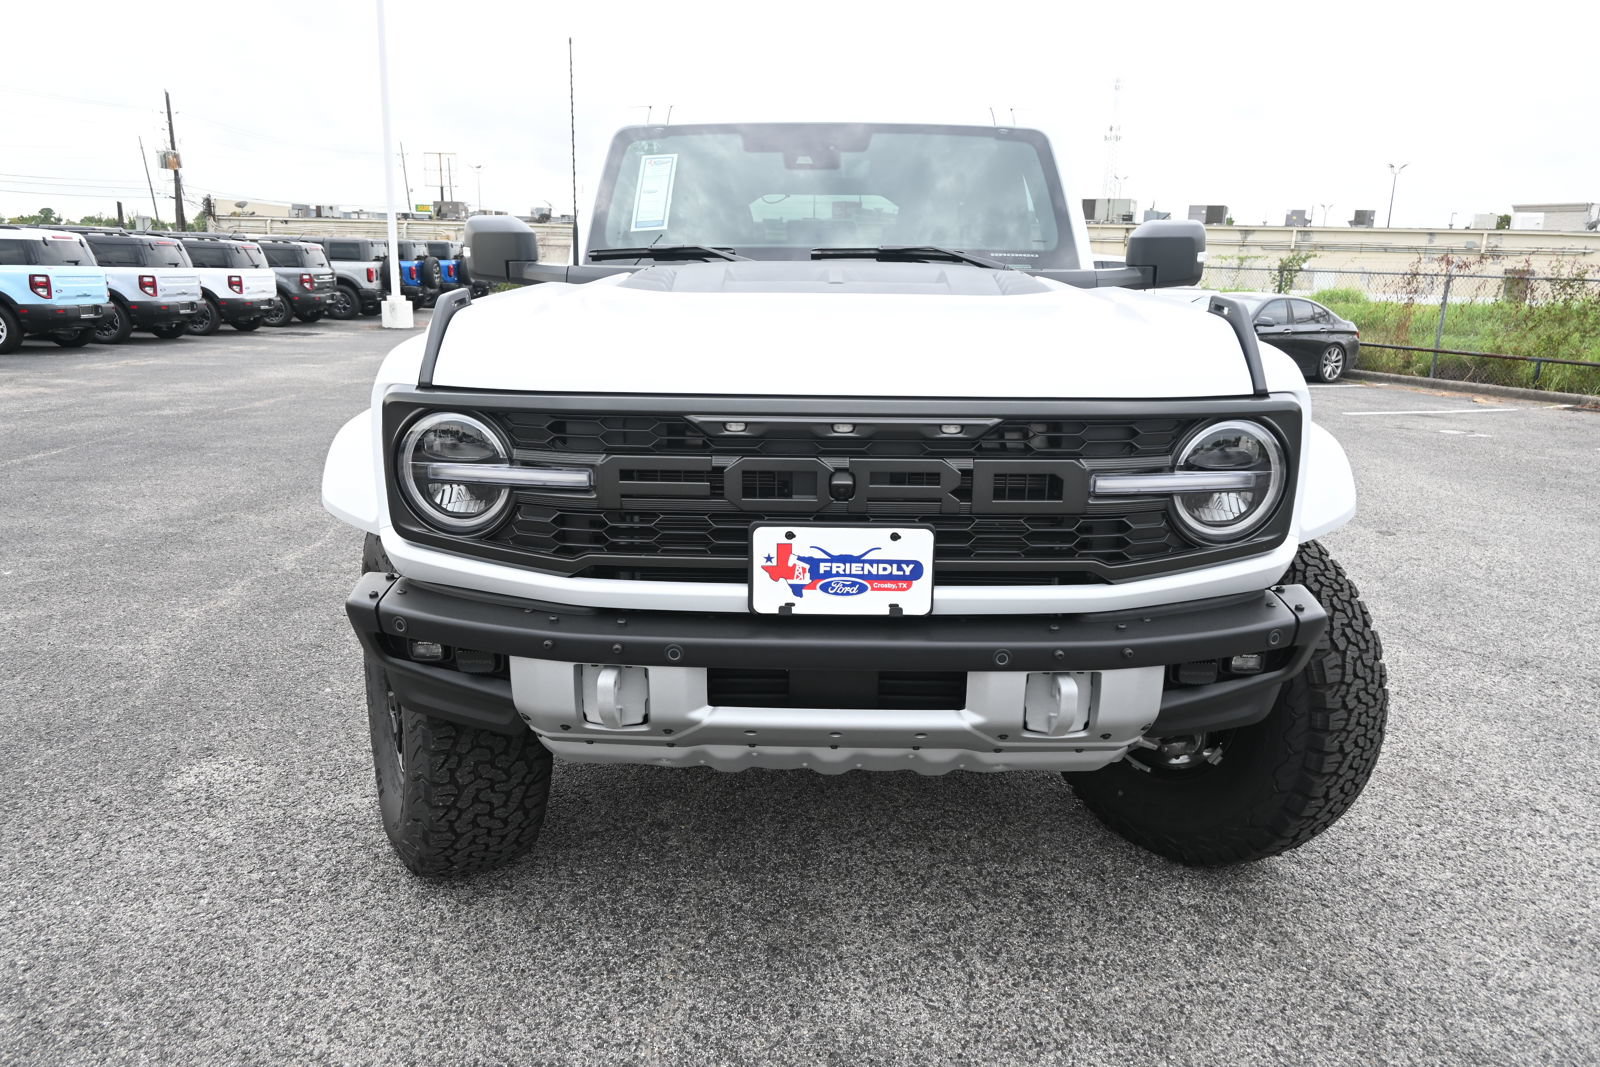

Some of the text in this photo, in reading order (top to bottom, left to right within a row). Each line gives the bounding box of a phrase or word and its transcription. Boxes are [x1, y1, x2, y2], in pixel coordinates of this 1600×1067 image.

[600, 455, 1089, 515] FORD
[819, 562, 914, 575] FRIENDLY
[828, 580, 859, 595] Ford
